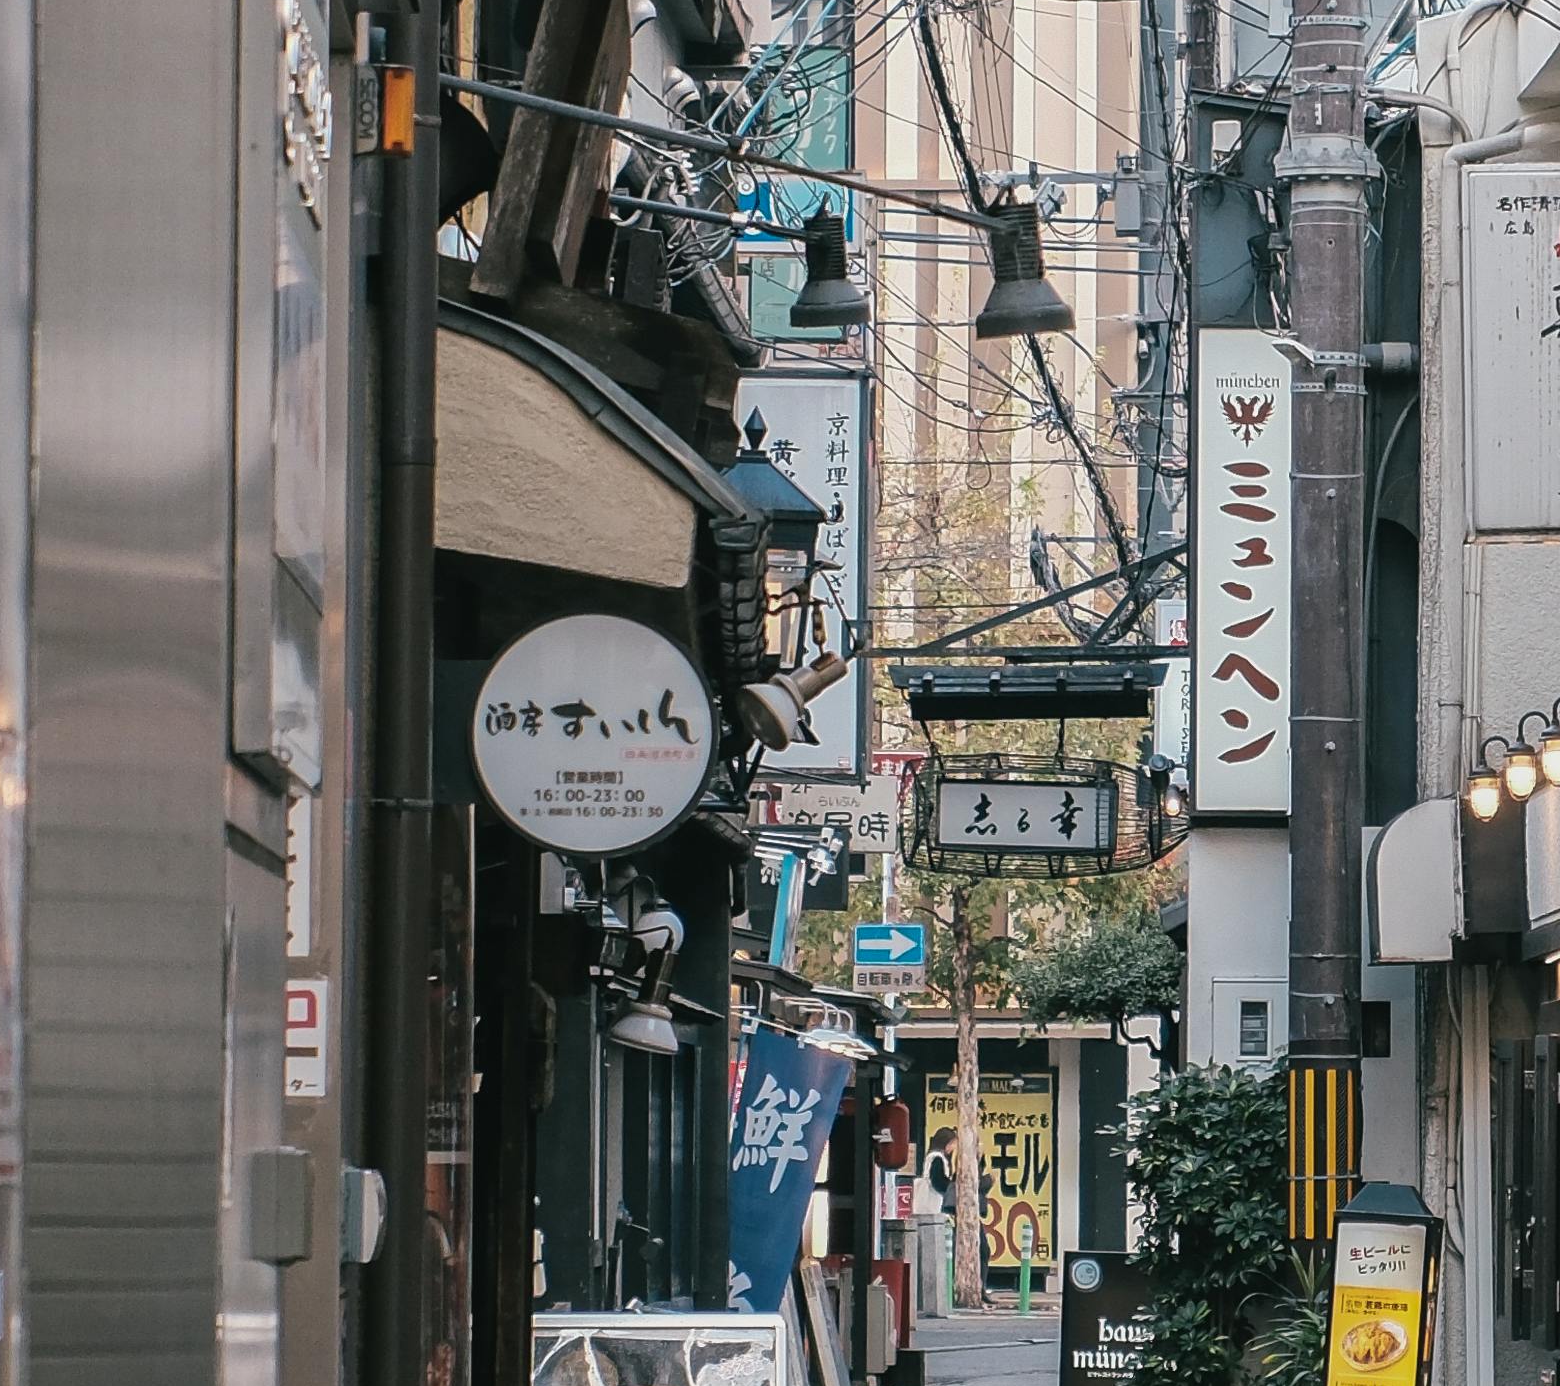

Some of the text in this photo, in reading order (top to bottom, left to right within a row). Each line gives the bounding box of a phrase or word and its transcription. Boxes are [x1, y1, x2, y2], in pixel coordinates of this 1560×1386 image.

[359, 77, 377, 140] SECOM
[1215, 372, 1281, 389] münchen
[1212, 461, 1280, 764] ミュンヘン
[550, 688, 700, 746] すいしん
[978, 1113, 1050, 1130] 杯飲んでも
[1350, 1245, 1411, 1261] 生ビールに
